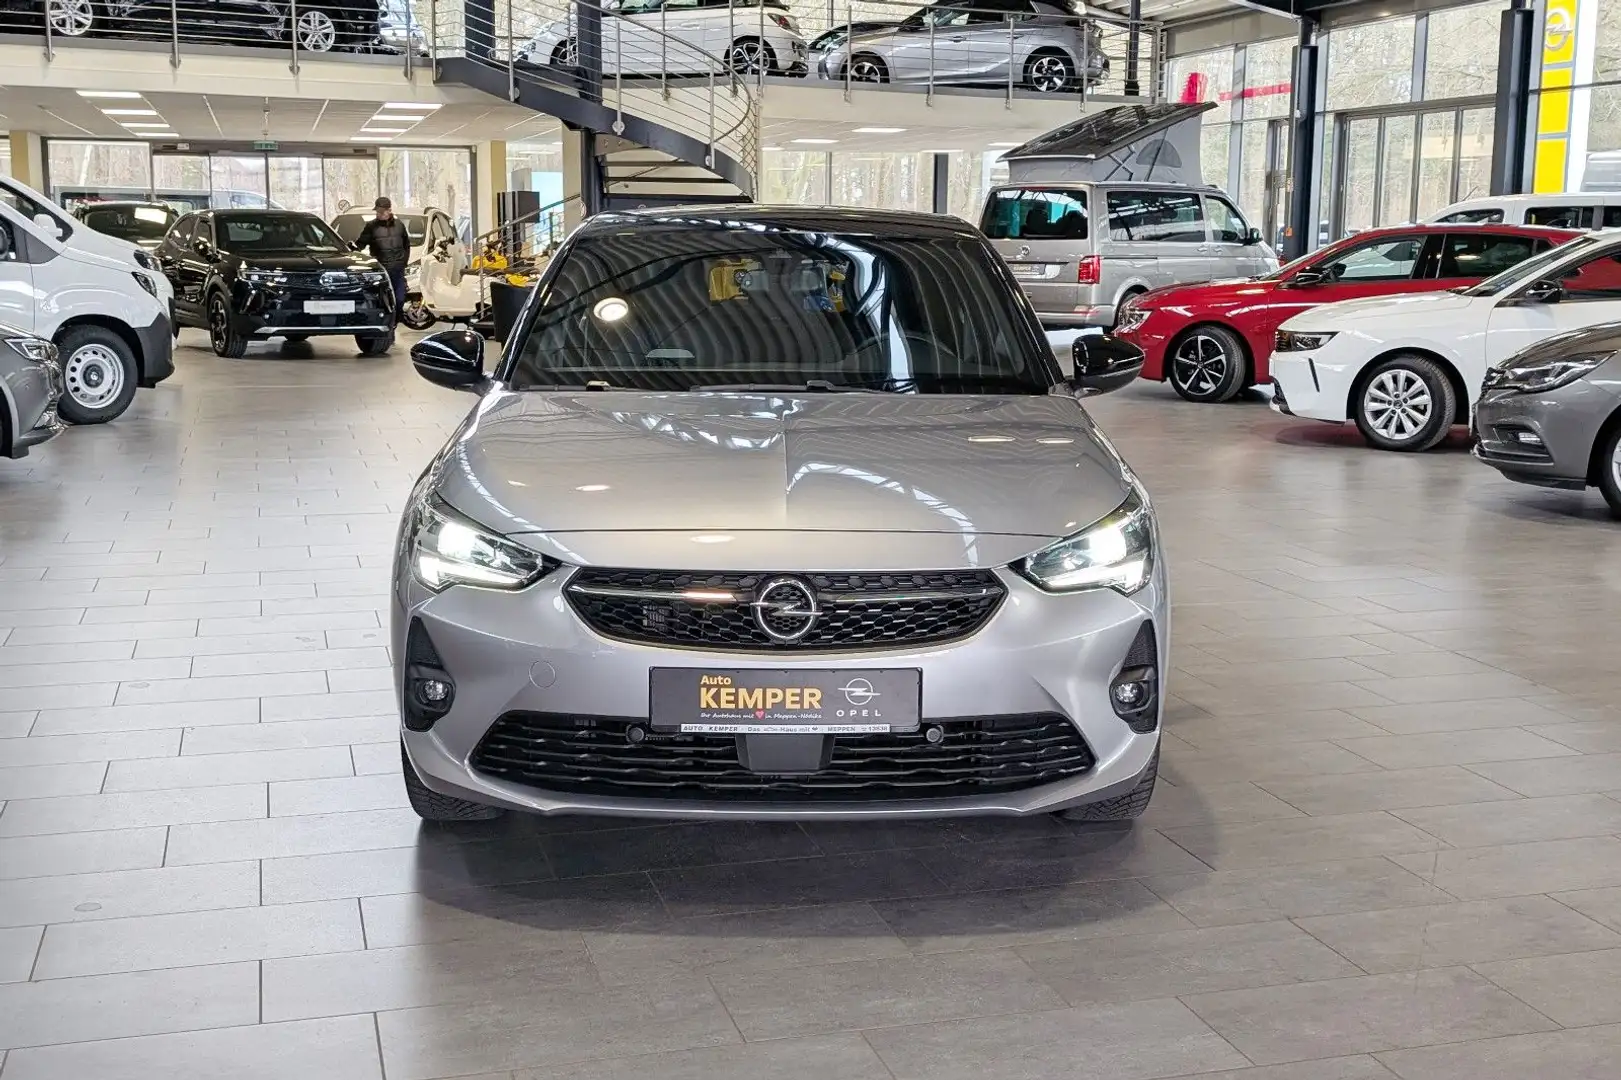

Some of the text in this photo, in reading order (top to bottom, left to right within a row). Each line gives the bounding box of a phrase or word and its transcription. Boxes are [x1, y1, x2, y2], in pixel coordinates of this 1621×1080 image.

[700, 675, 731, 685] Auto
[700, 687, 822, 709] KEMPER
[836, 709, 881, 717] OPEL
